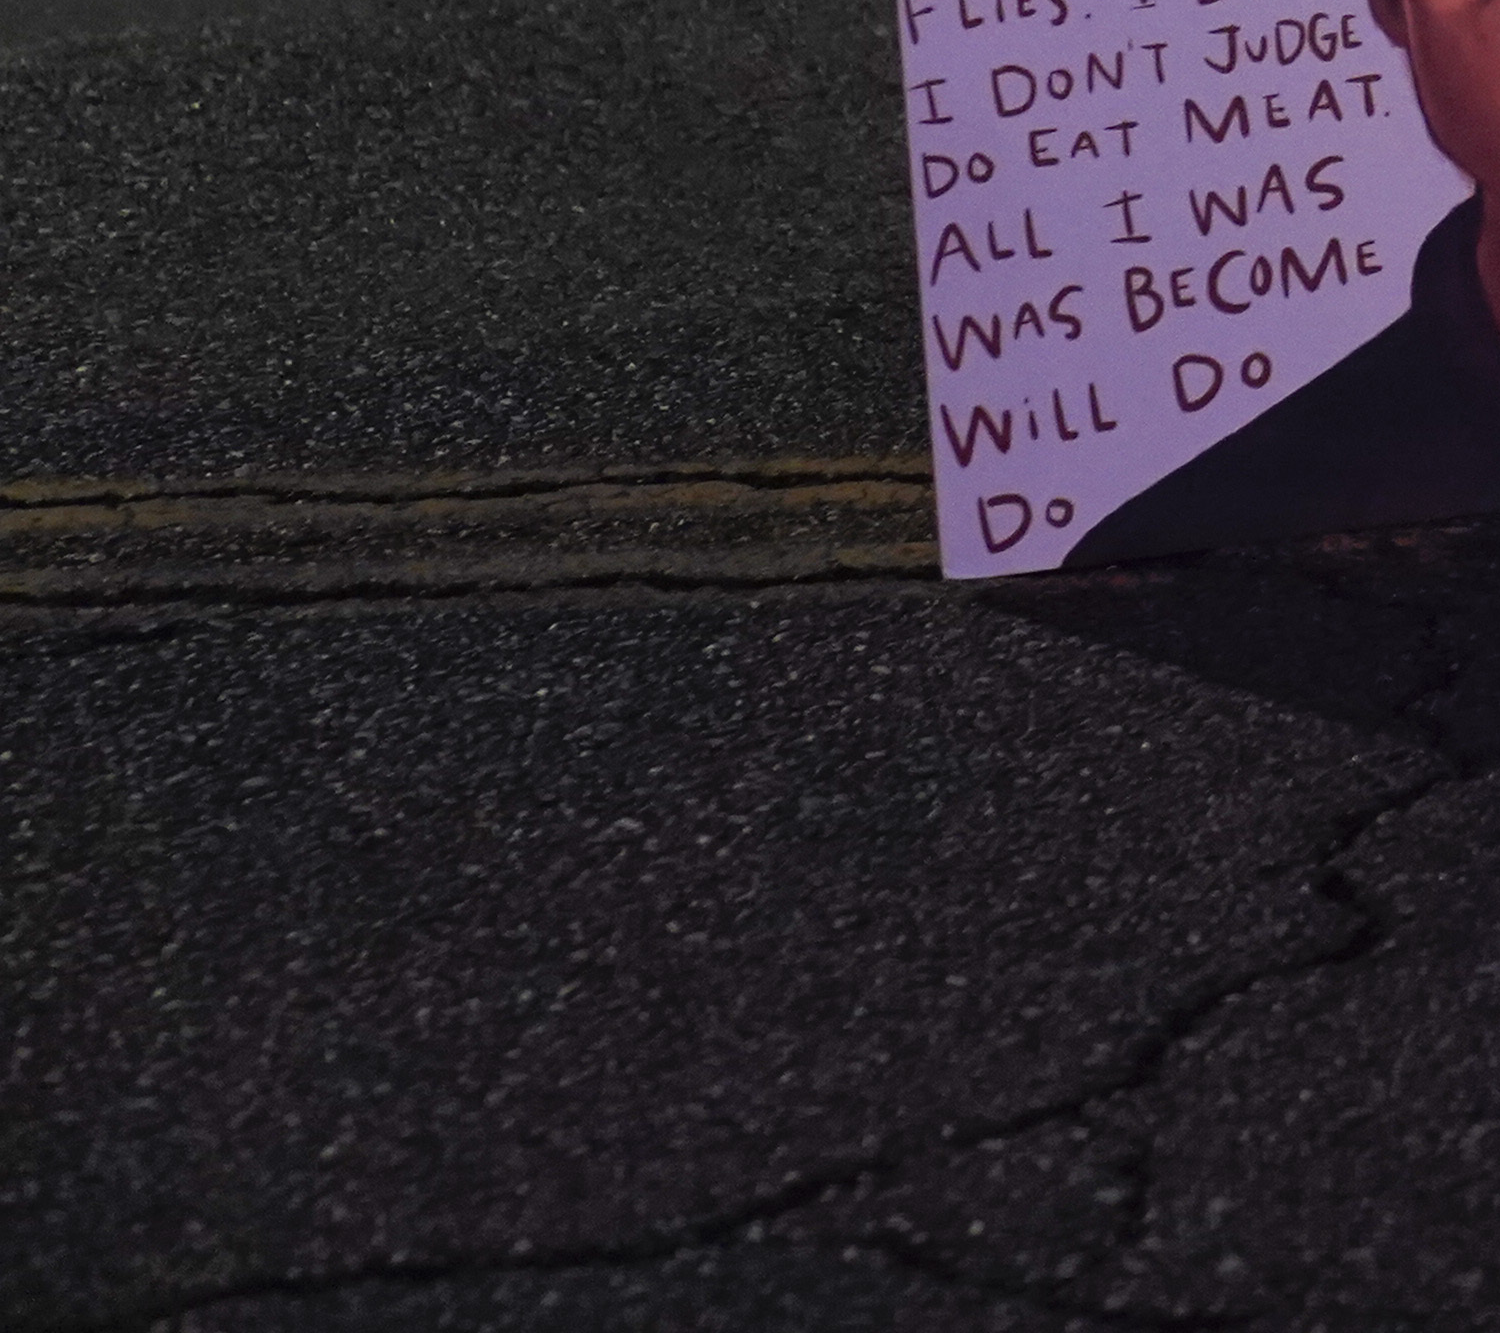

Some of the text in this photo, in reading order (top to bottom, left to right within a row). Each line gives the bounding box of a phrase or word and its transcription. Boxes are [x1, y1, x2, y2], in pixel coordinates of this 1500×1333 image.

[910, 78, 954, 126] I
[990, 42, 1168, 118] DON'T
[1204, 12, 1362, 74] JUDGE
[921, 152, 995, 199] DO
[1028, 121, 1138, 168] EAT
[930, 208, 1053, 287] ALL
[1104, 190, 1152, 244] I
[1188, 155, 1345, 237] WAS
[932, 285, 1083, 372] WAS
[1124, 238, 1383, 334] BECOME
[1172, 352, 1272, 413] DO
[977, 493, 1074, 554] DO
